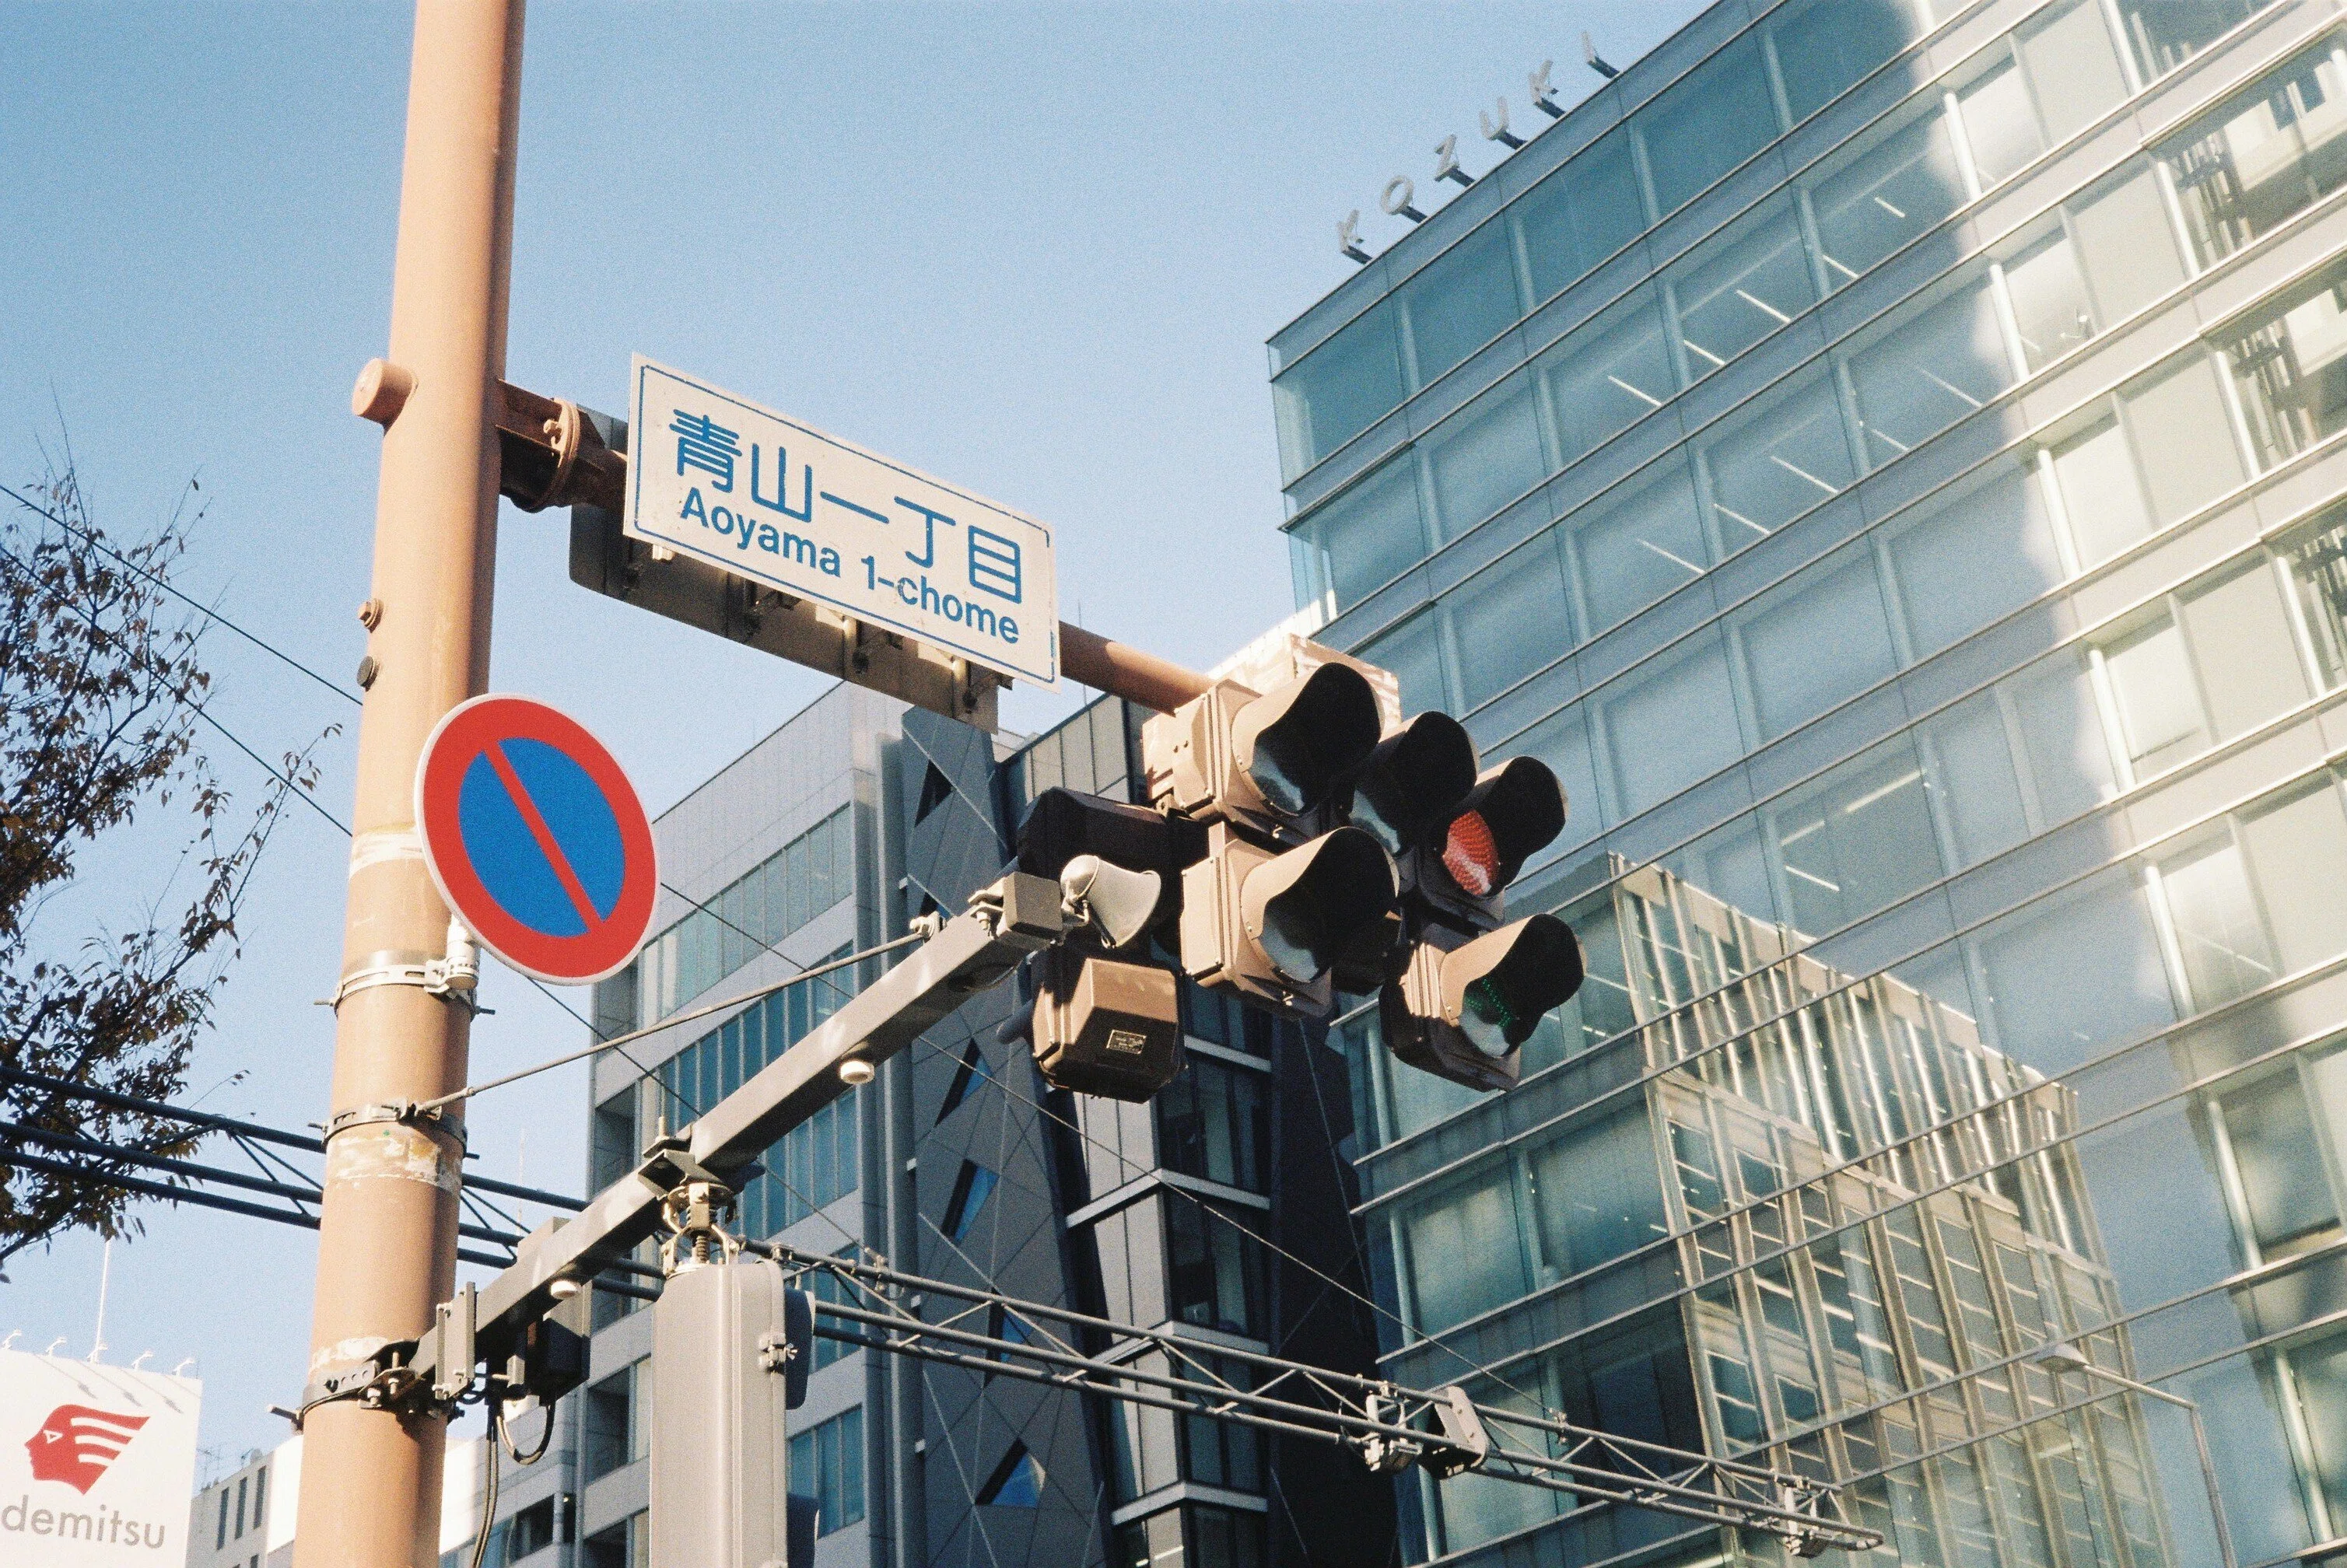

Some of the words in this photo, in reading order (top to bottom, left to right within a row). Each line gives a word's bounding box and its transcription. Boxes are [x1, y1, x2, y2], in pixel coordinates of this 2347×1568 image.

[1337, 30, 1597, 254] KOZUKI
[668, 408, 1022, 604] 青山一丁目
[679, 486, 841, 577] Aoyama
[860, 555, 1020, 644] 1-chome
[1, 1494, 166, 1549] demitsu
